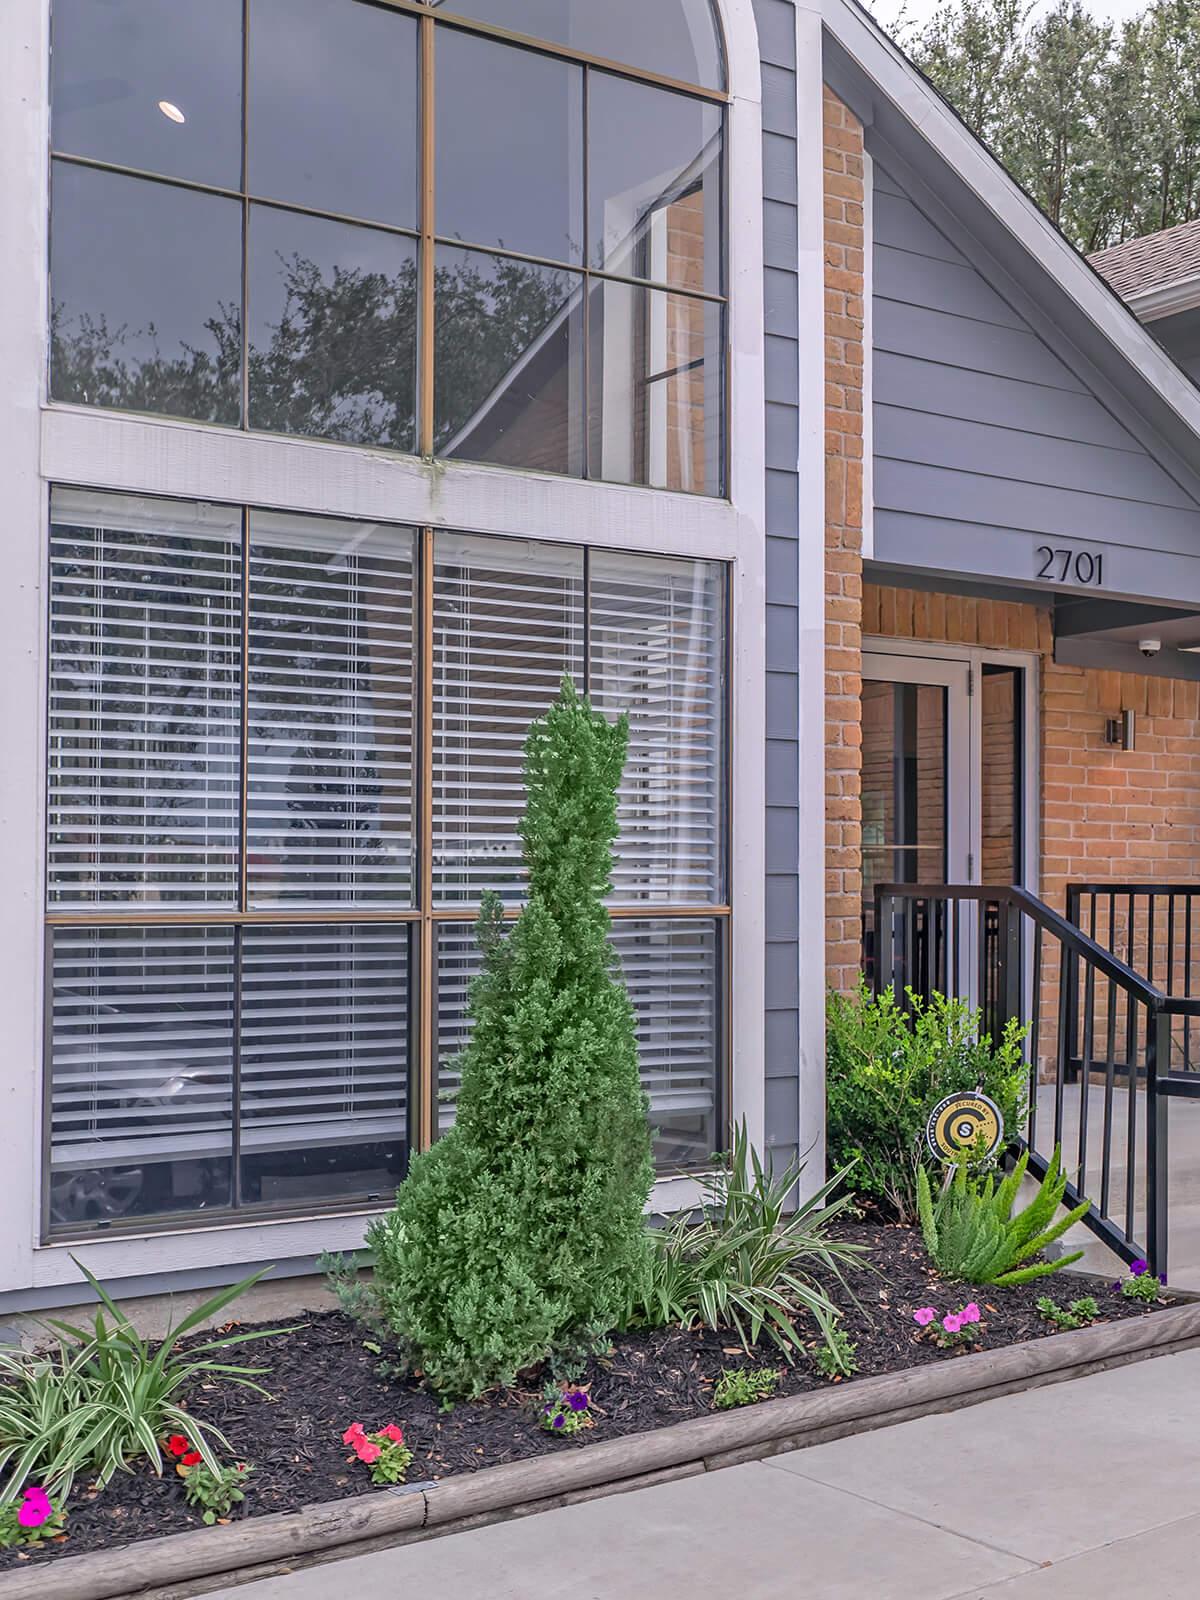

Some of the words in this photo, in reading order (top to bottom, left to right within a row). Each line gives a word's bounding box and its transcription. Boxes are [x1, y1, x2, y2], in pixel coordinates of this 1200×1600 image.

[1036, 546, 1103, 585] 2701
[955, 1101, 982, 1109] SECURED
[981, 1107, 989, 1116] BY
[960, 1123, 972, 1137] S
